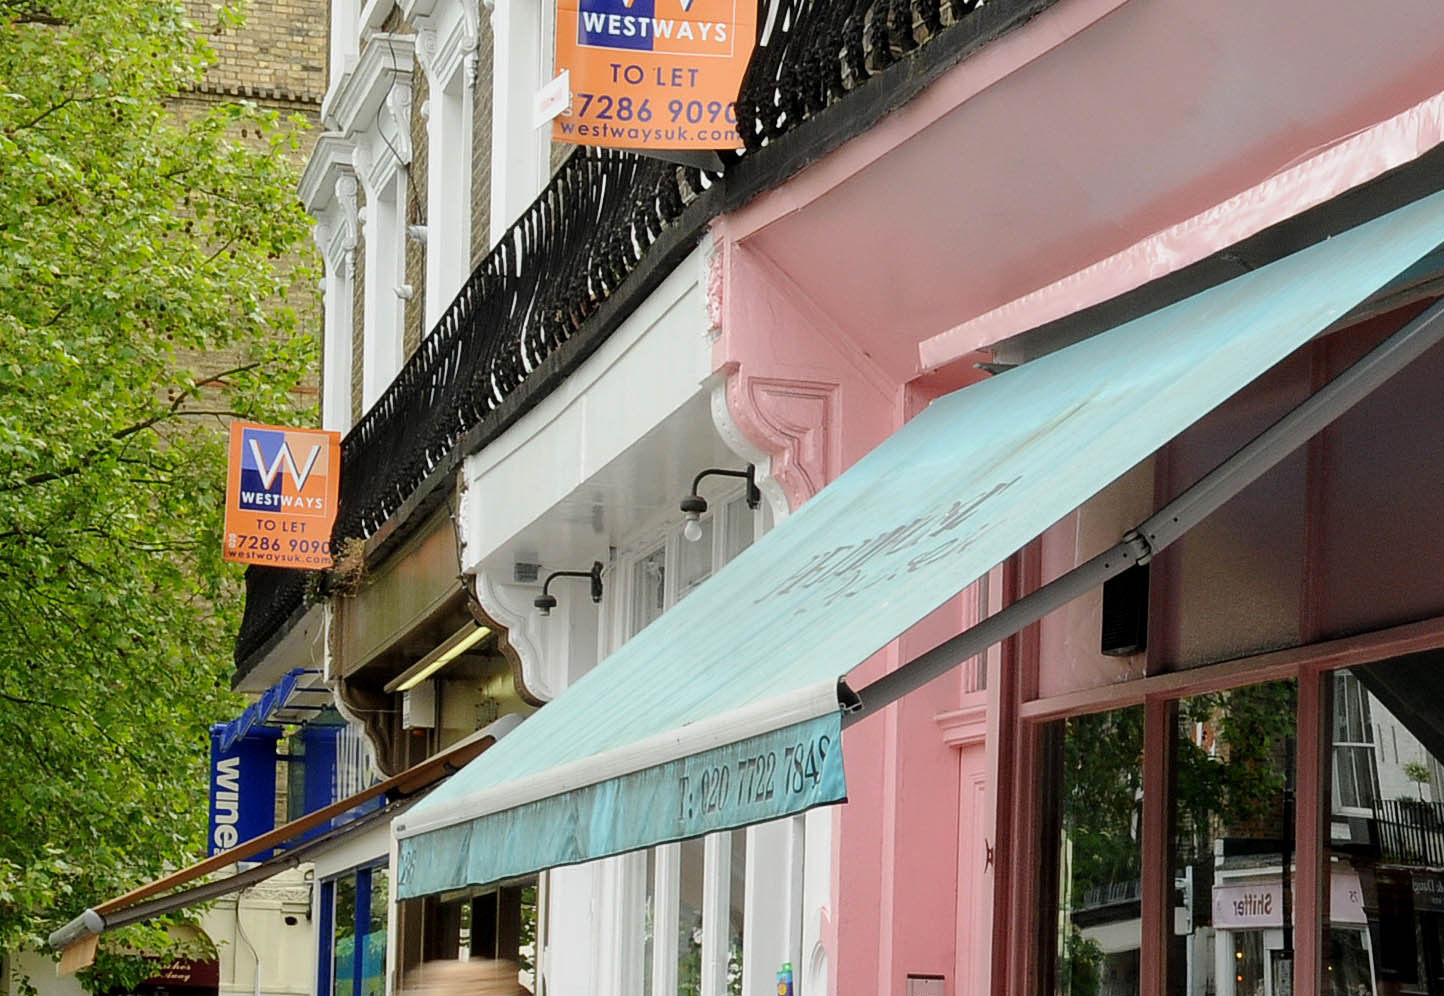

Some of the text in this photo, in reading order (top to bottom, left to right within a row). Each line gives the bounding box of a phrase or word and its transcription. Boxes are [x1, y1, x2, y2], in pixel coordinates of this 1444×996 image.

[582, 11, 728, 42] WESTWAYS
[610, 63, 699, 87] TO LET
[577, 93, 653, 122] 7286
[560, 121, 742, 143] westwaysuk.com
[241, 490, 324, 509] WESTWAYS
[256, 519, 307, 533] TO LET
[238, 535, 331, 555] 7286 9090
[700, 764, 730, 814] 020
[737, 751, 777, 804] 7722
[214, 756, 241, 849] wine
